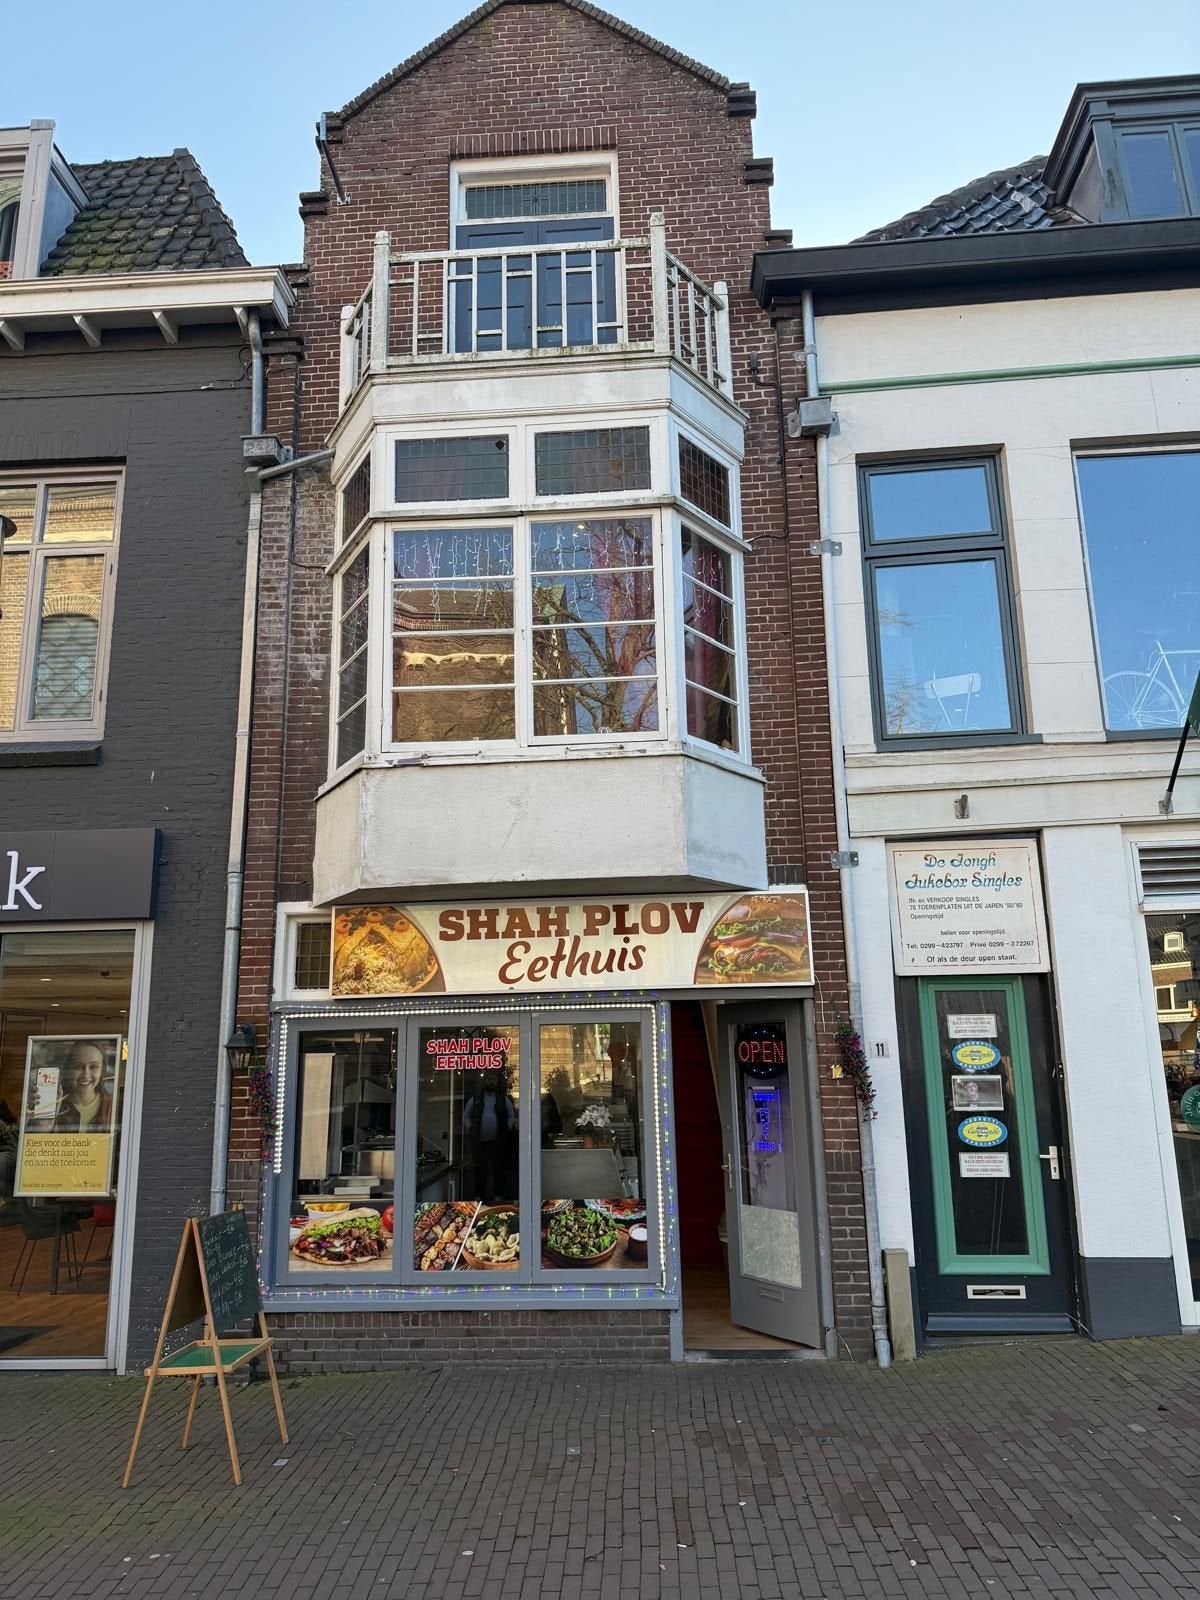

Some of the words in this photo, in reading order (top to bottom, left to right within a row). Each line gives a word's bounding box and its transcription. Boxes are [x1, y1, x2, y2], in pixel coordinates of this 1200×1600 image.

[923, 854, 946, 868] De
[950, 852, 996, 870] Jongh
[0, 850, 46, 910] k
[905, 873, 968, 889] Jukebox
[971, 872, 1023, 892] Singles
[439, 905, 570, 941] SHAH
[583, 902, 704, 936] PLOV
[499, 935, 647, 985] Eethuis
[978, 955, 996, 963] open
[426, 1039, 470, 1054] SHAH
[472, 1037, 513, 1053] PLOV
[738, 1041, 784, 1062] OPEN
[875, 1042, 884, 1056] 11
[436, 1054, 503, 1070] EETHUIS
[26, 1139, 45, 1147] Kies
[61, 1138, 71, 1147] de
[72, 1138, 91, 1147] bank
[25, 1148, 36, 1157] die
[37, 1148, 60, 1157] denkt
[76, 1149, 88, 1158] jou
[24, 1159, 34, 1167] en
[34, 1159, 48, 1167] aan
[50, 1158, 60, 1167] de
[60, 1158, 97, 1167] toekomst
